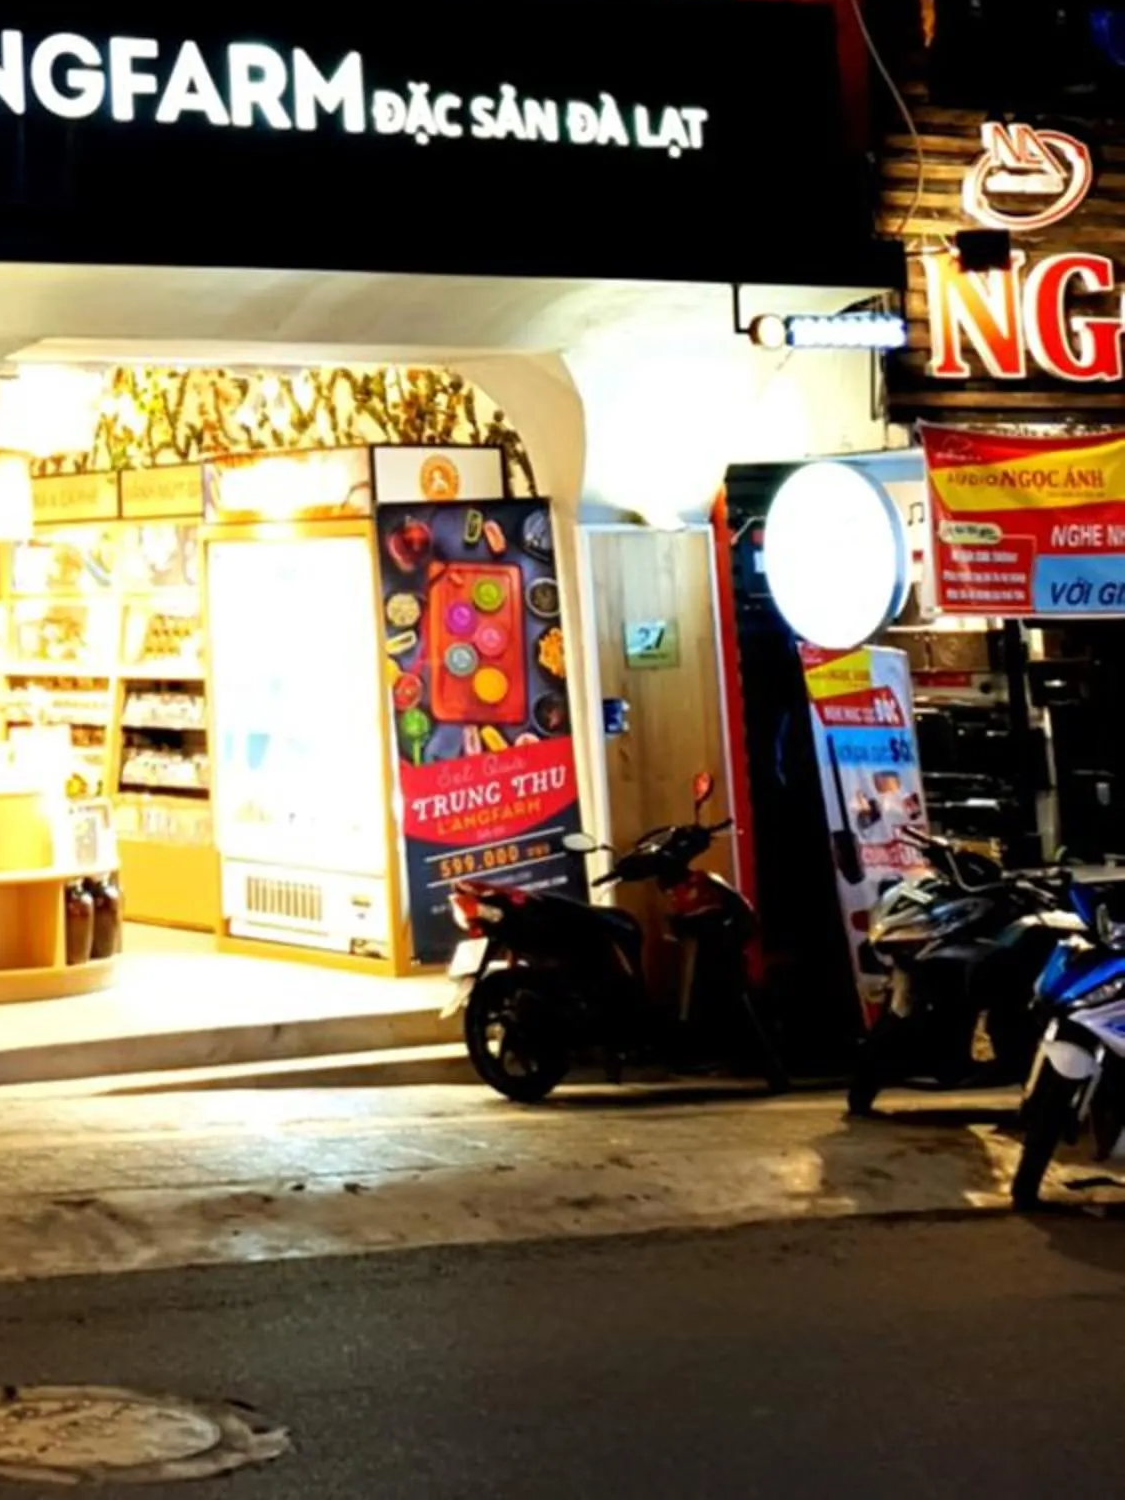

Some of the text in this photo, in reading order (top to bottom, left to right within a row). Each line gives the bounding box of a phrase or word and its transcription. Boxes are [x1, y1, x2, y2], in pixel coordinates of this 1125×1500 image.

[372, 81, 463, 145] ĐẶC
[470, 83, 559, 142] SẢN
[566, 92, 629, 145] ĐÀ
[635, 104, 708, 158] LẠT
[923, 247, 1125, 380] NG
[999, 470, 1059, 492] NGỌC
[1050, 524, 1104, 547] NGHE
[1049, 577, 1094, 607] VỚI
[411, 764, 567, 822] TRUNG THU
[438, 843, 520, 879] 599.000
